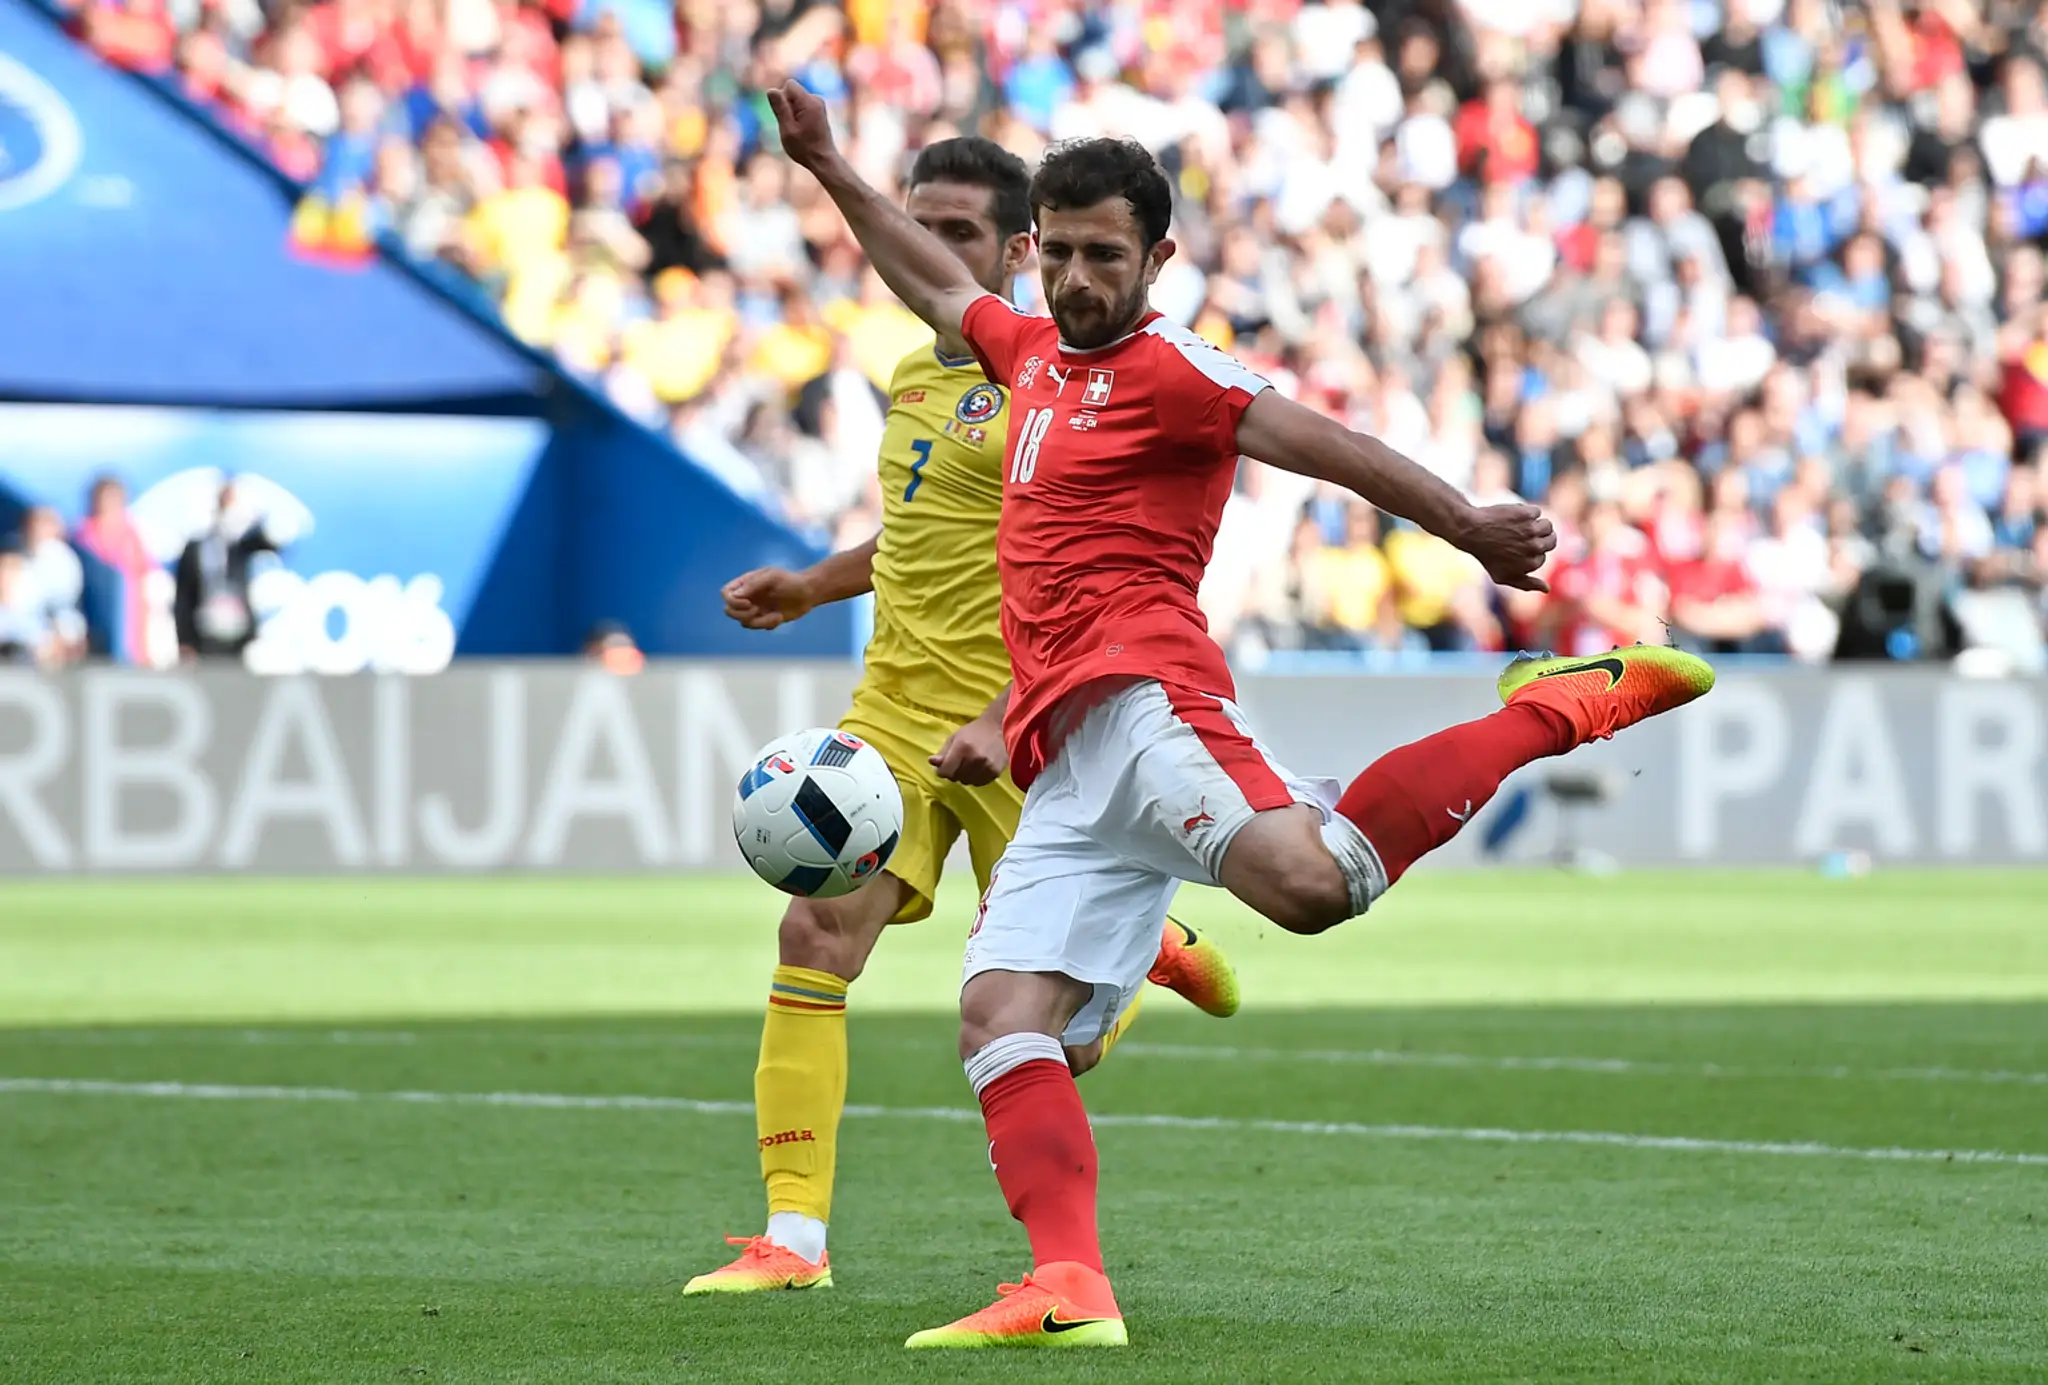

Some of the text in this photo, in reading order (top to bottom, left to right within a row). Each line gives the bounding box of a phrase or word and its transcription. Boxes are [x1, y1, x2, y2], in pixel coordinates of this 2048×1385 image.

[903, 439, 933, 502] 7
[1009, 407, 1054, 483] 18
[1680, 678, 2048, 857] PAR
